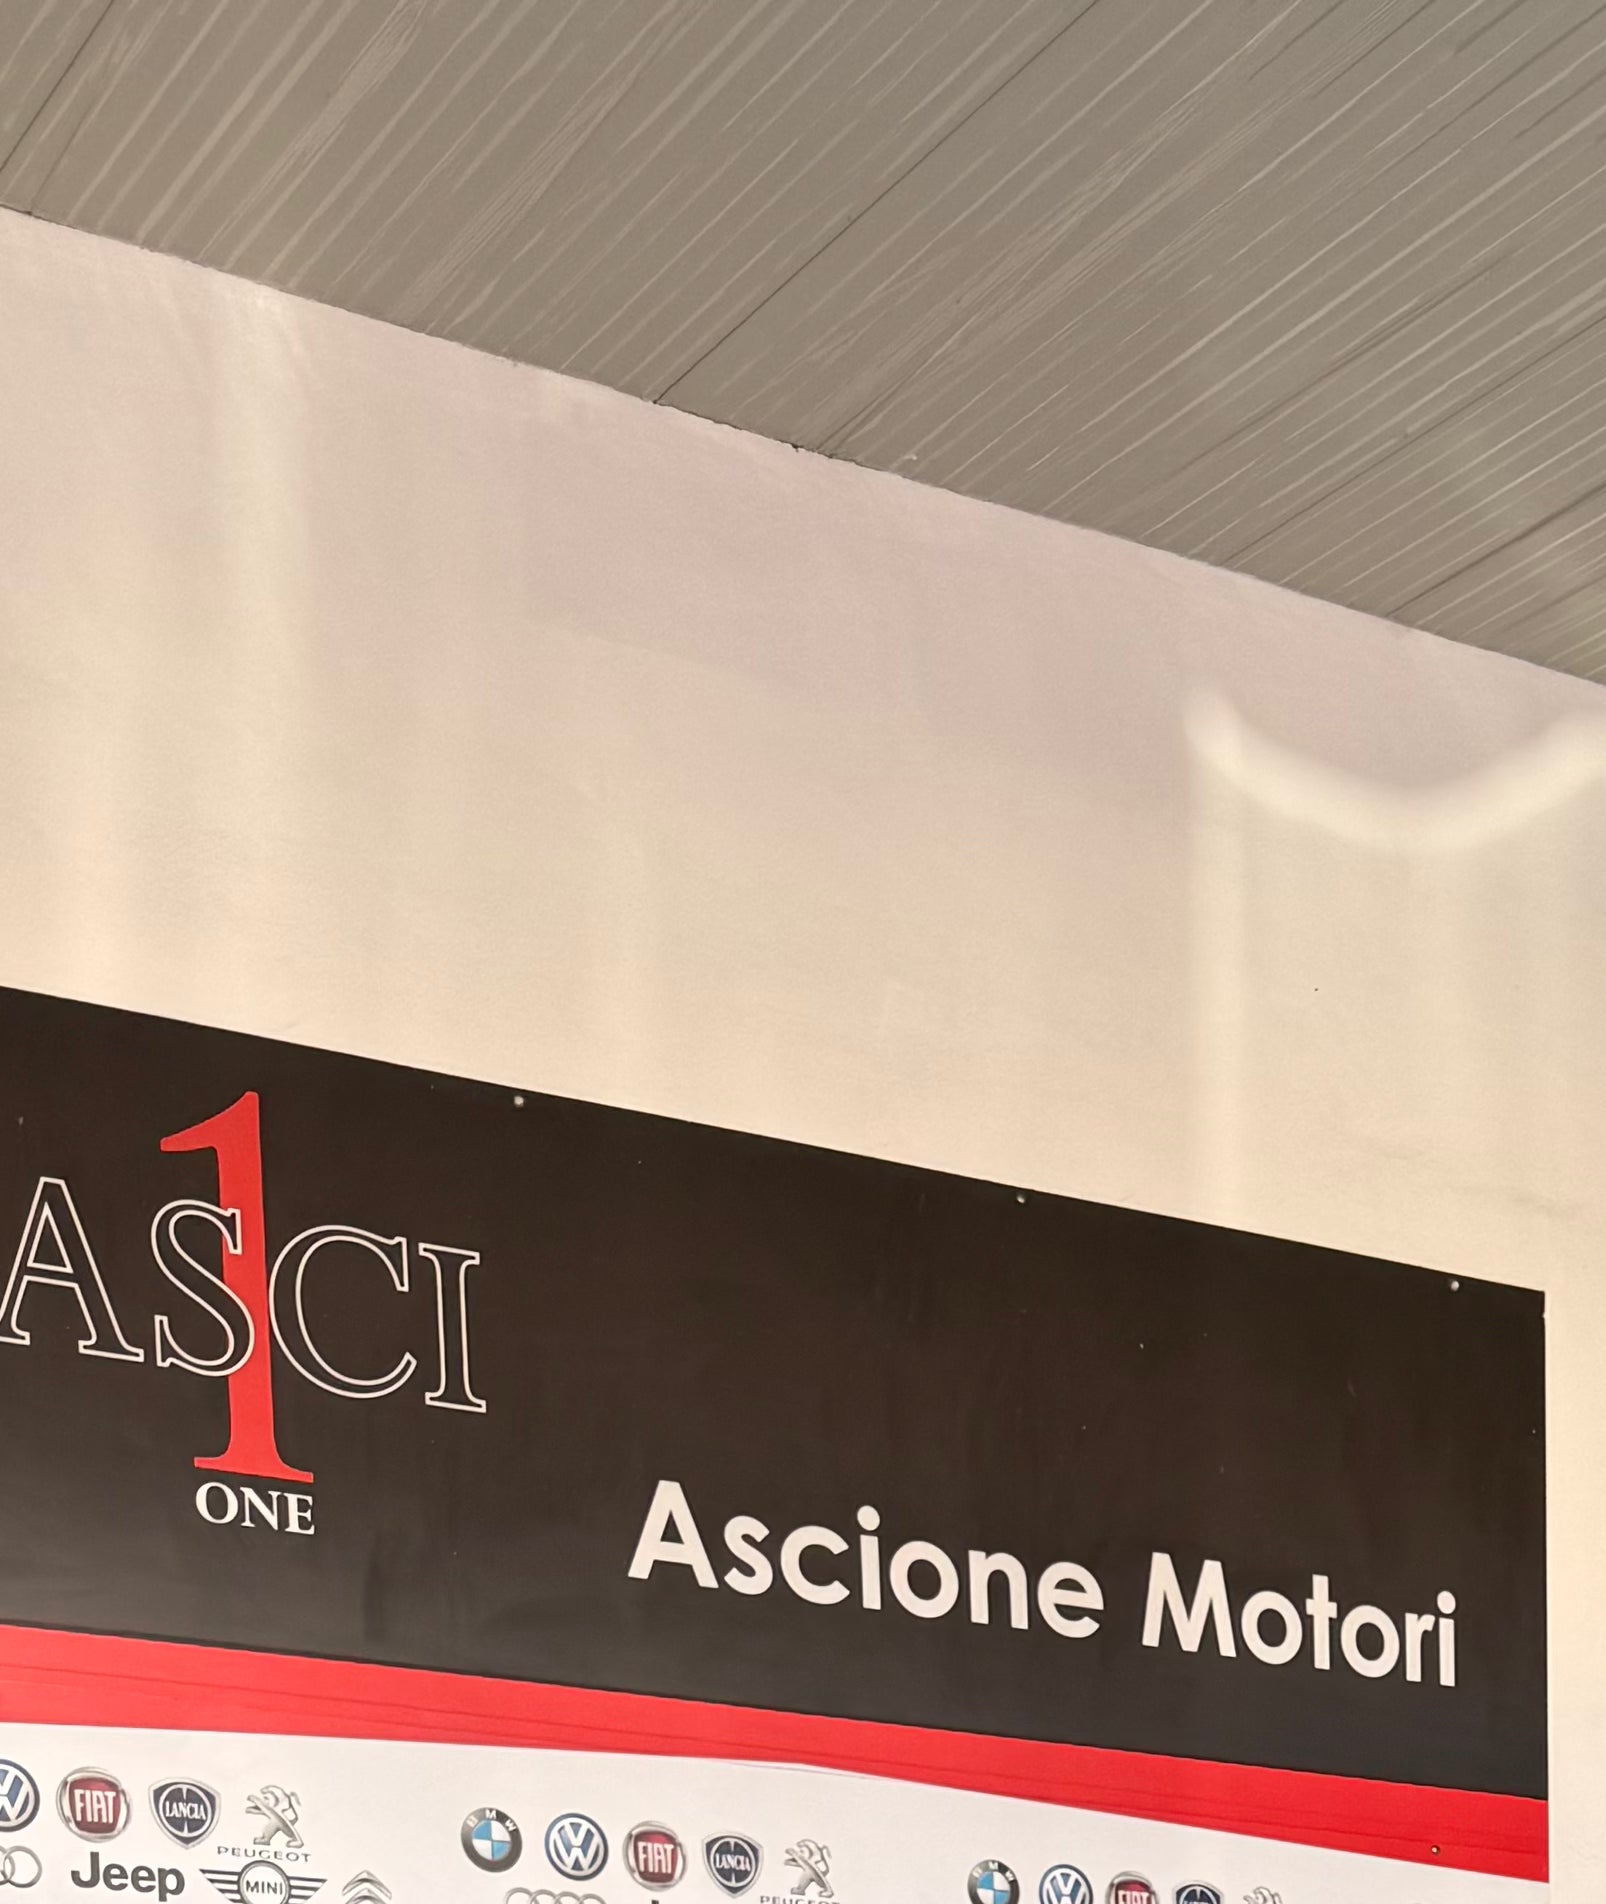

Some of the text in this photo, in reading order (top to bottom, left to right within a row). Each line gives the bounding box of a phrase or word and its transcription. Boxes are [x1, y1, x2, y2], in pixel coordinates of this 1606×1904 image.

[195, 1481, 315, 1535] ONE
[627, 1479, 1457, 1687] Ascione Motori
[74, 1789, 117, 1824] FIAT
[165, 1800, 207, 1820] LANCIA
[217, 1845, 312, 1863] PEUGEOT
[637, 1841, 674, 1875] FIAT
[71, 1851, 186, 1902] Jeep
[245, 1880, 283, 1896] MINI
